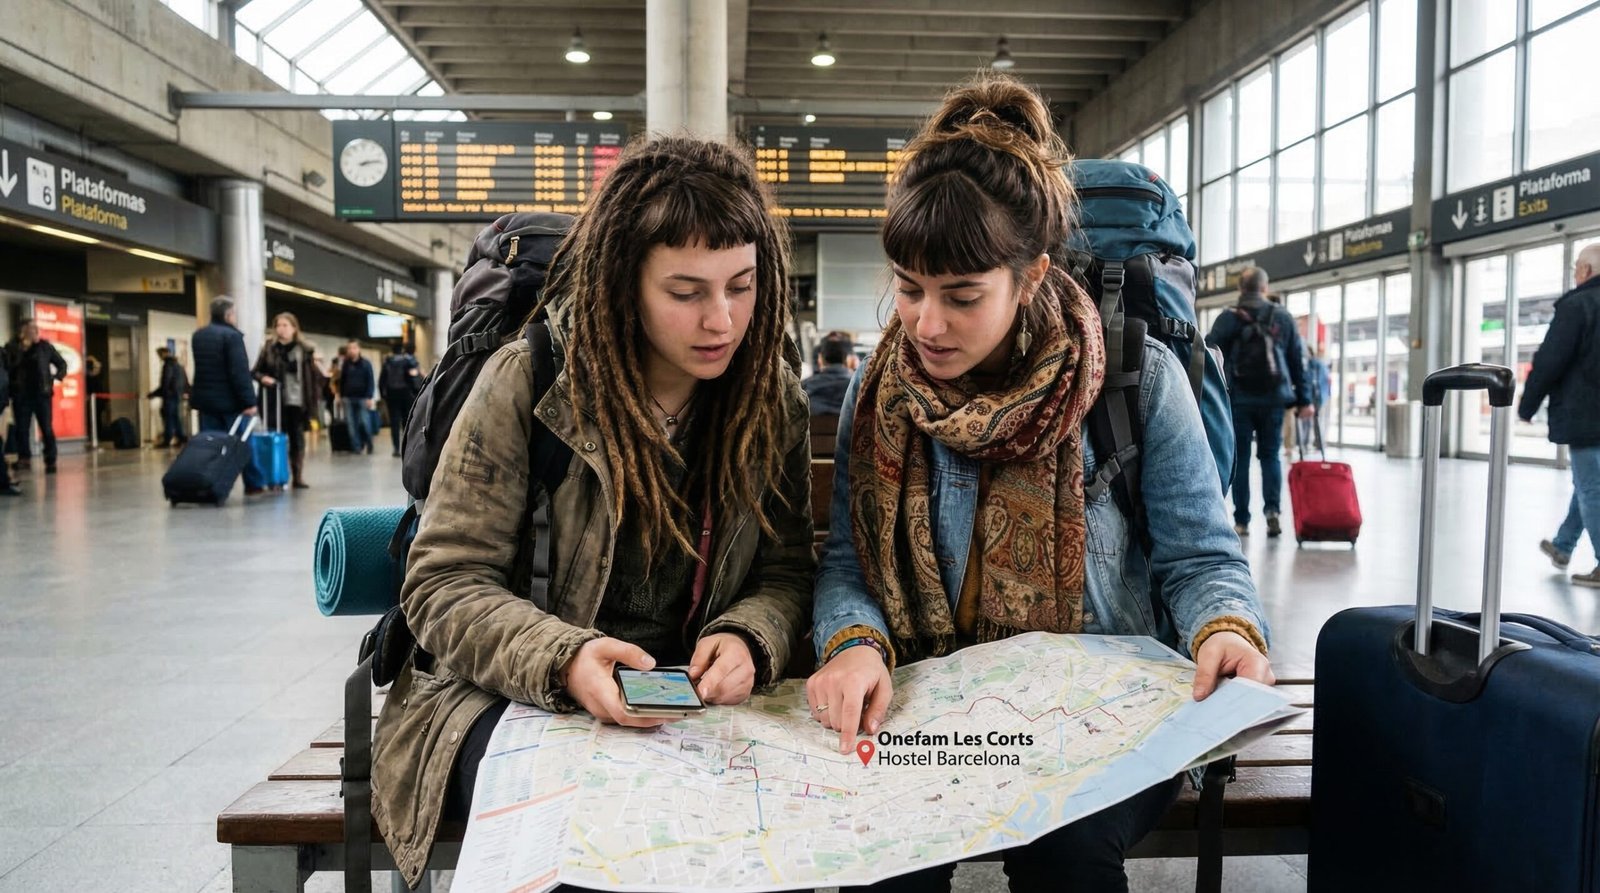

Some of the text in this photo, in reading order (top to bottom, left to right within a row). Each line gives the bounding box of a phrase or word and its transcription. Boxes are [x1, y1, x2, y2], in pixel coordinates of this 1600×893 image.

[43, 186, 52, 206] 6
[61, 167, 146, 214] Plataformas
[1519, 167, 1591, 197] Plataforma
[61, 195, 128, 230] Plataforma
